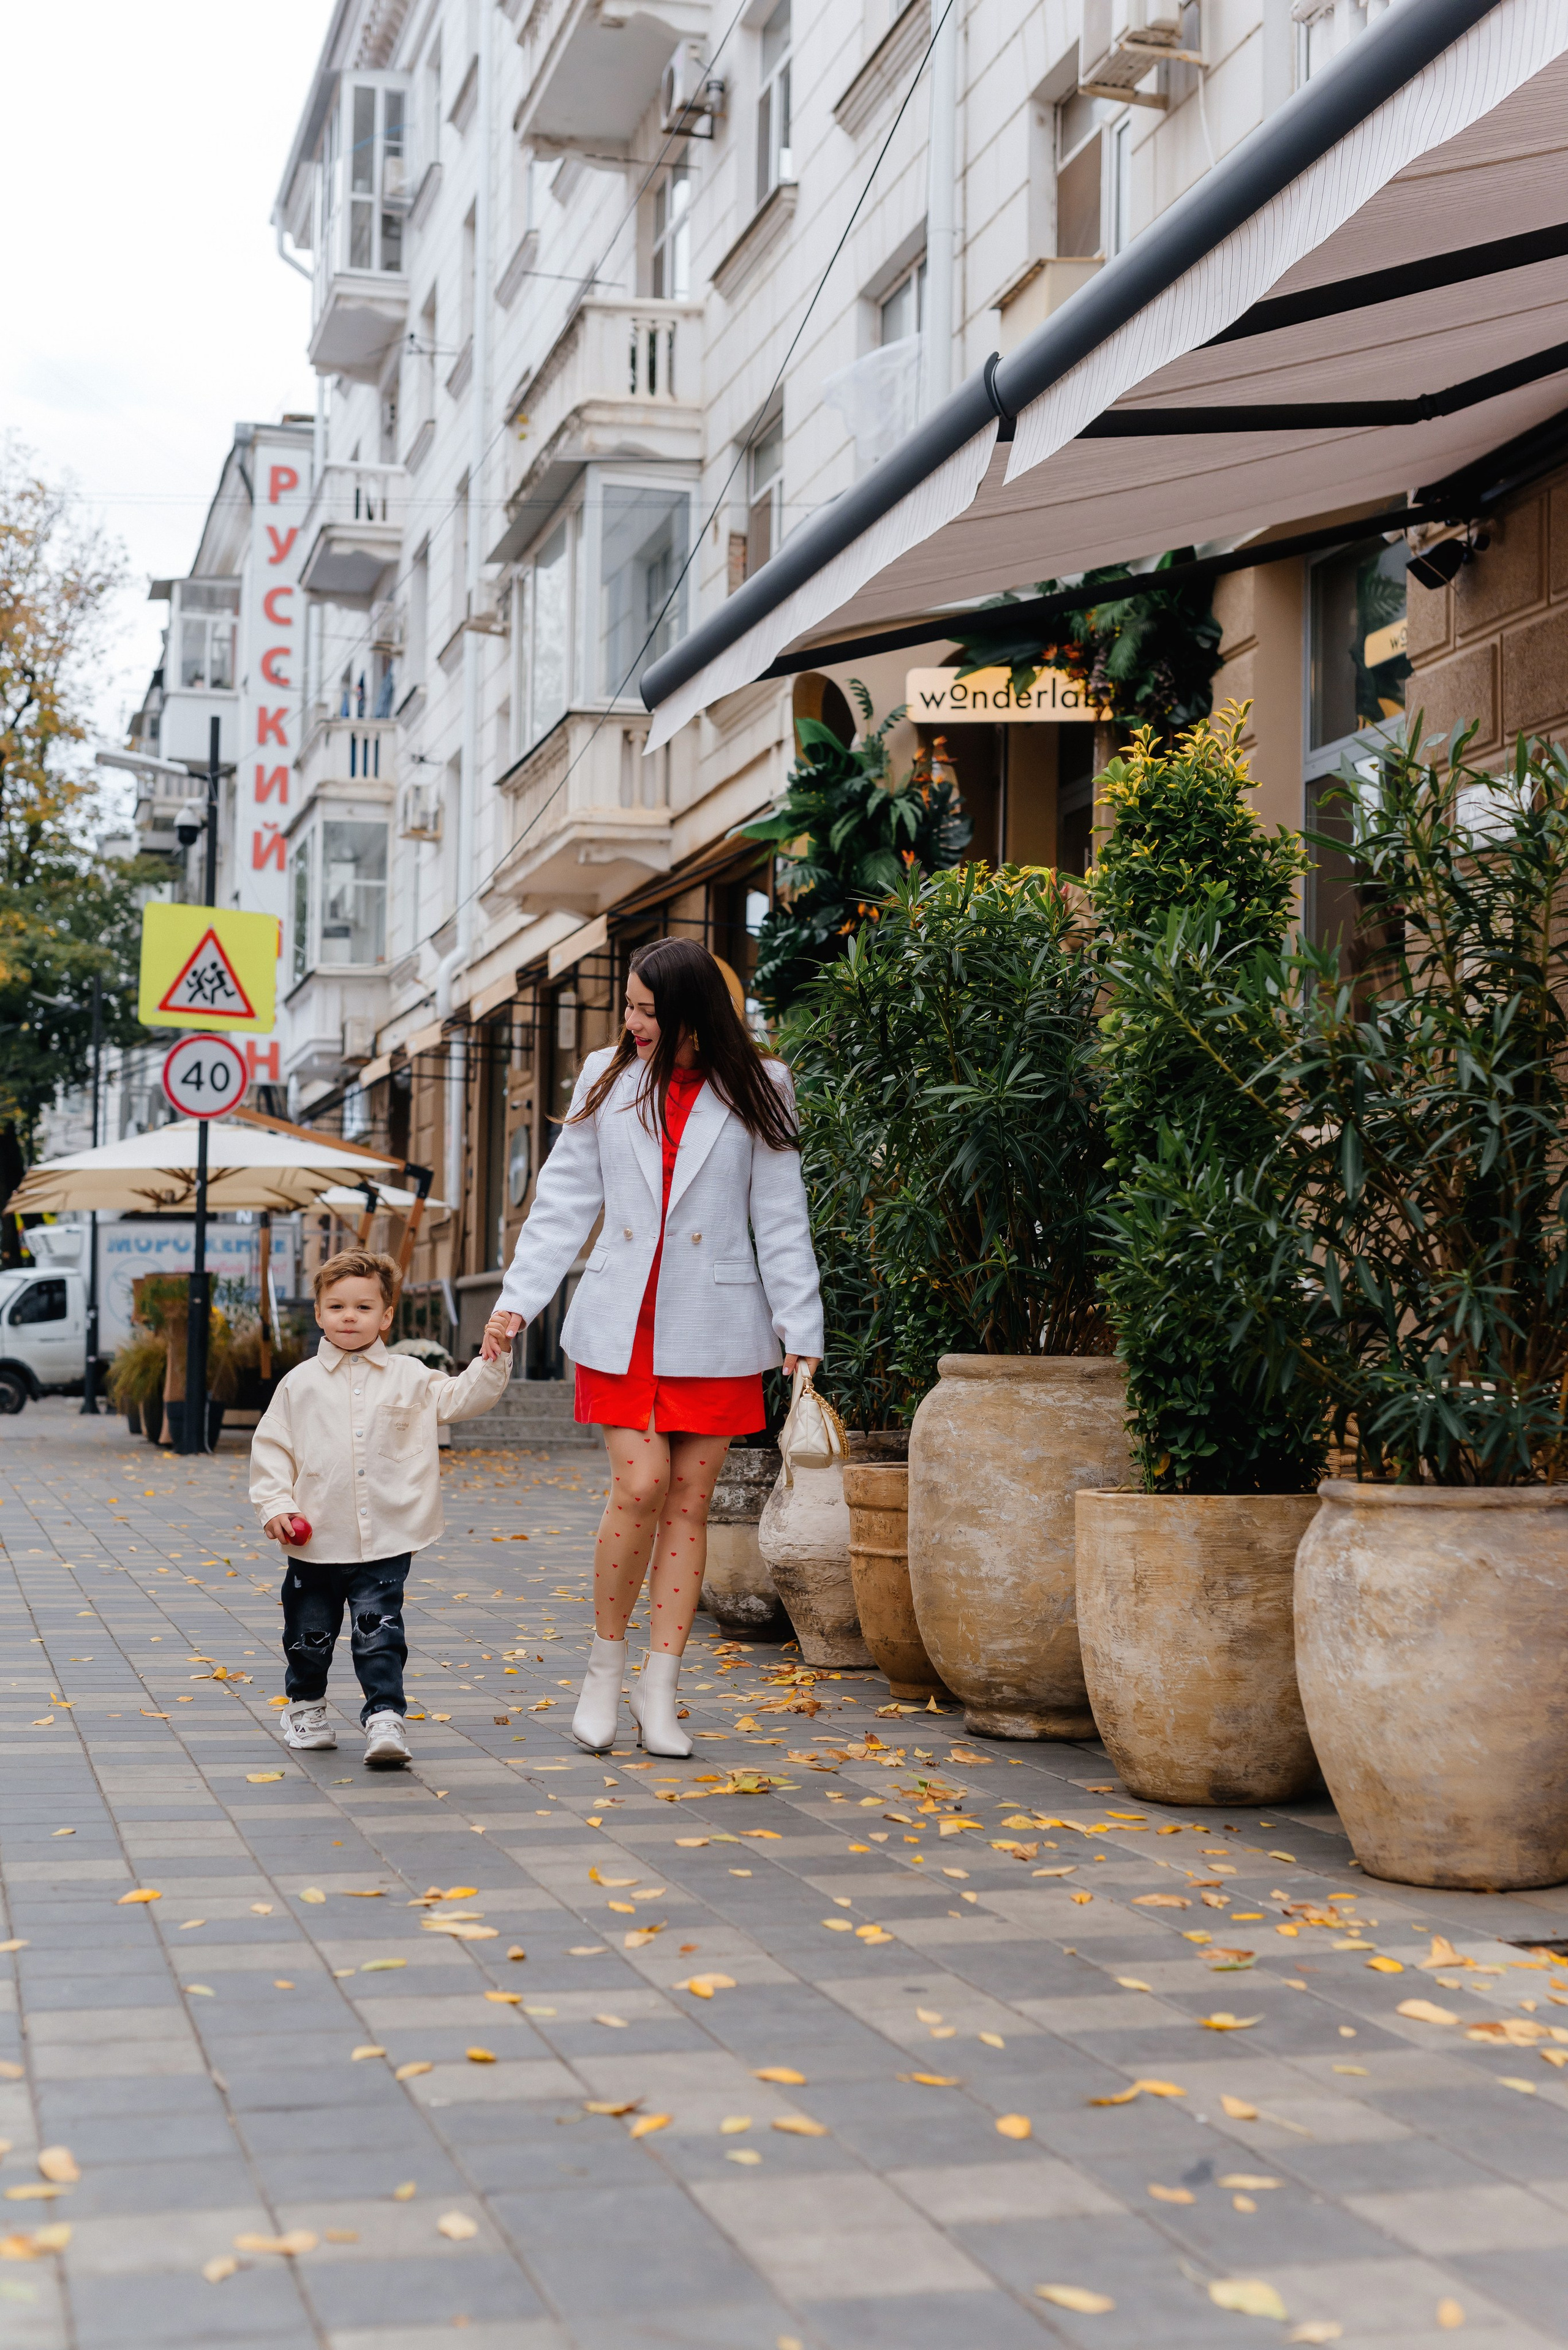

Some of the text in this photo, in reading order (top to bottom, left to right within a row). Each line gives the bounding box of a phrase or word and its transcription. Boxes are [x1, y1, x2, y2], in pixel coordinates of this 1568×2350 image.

[252, 465, 299, 871] РУССКИЙ
[181, 1061, 230, 1091] 40
[107, 1232, 285, 1253] МОРОЕНЕ
